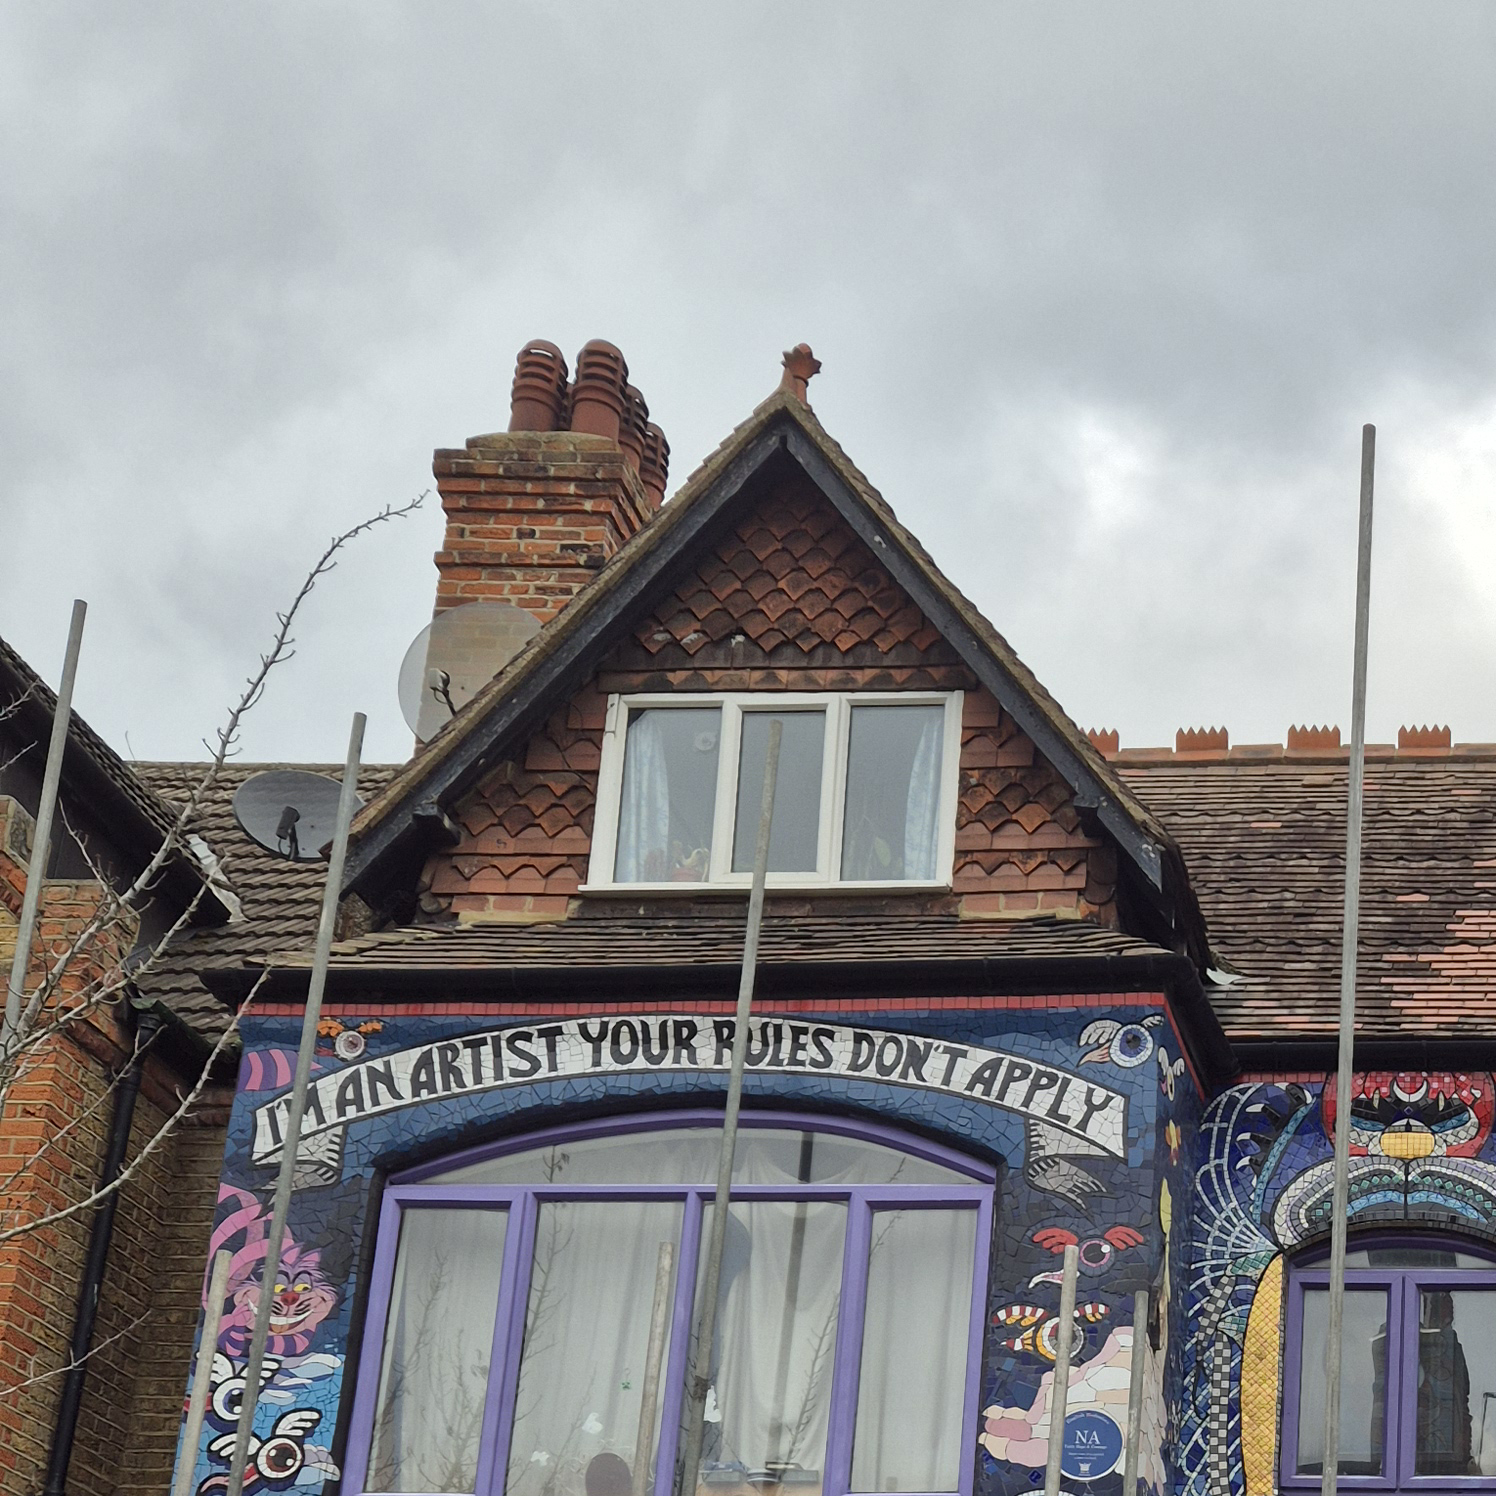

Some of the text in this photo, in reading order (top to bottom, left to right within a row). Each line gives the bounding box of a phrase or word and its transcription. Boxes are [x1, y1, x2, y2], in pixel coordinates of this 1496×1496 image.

[267, 1018, 1117, 1148] I'M AN ARTIST YOUR RULES DON'T APPLY
[1075, 1429, 1101, 1445] NA
